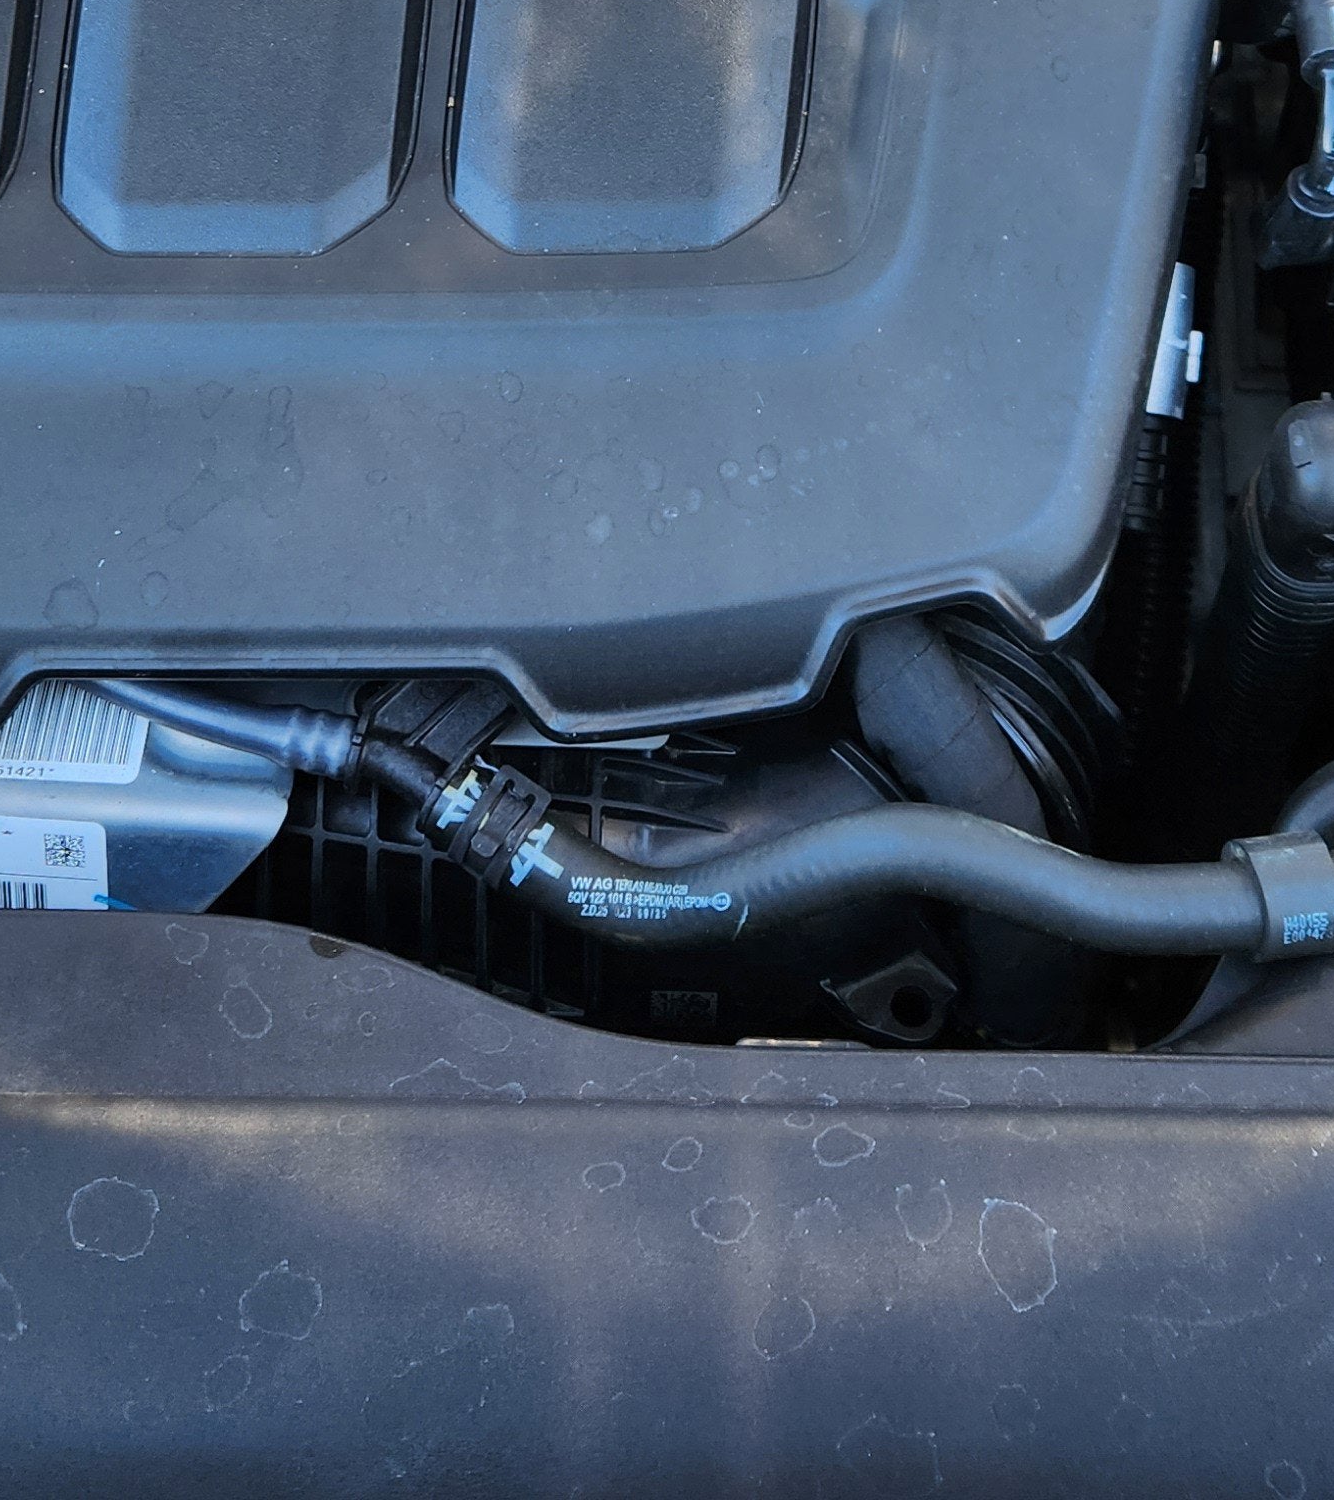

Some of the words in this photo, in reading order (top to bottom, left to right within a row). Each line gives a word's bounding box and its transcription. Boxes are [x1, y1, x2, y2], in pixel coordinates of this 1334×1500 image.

[571, 876, 593, 890] VW
[593, 877, 613, 891] AG
[589, 892, 606, 904] 122
[608, 893, 624, 904] 101
